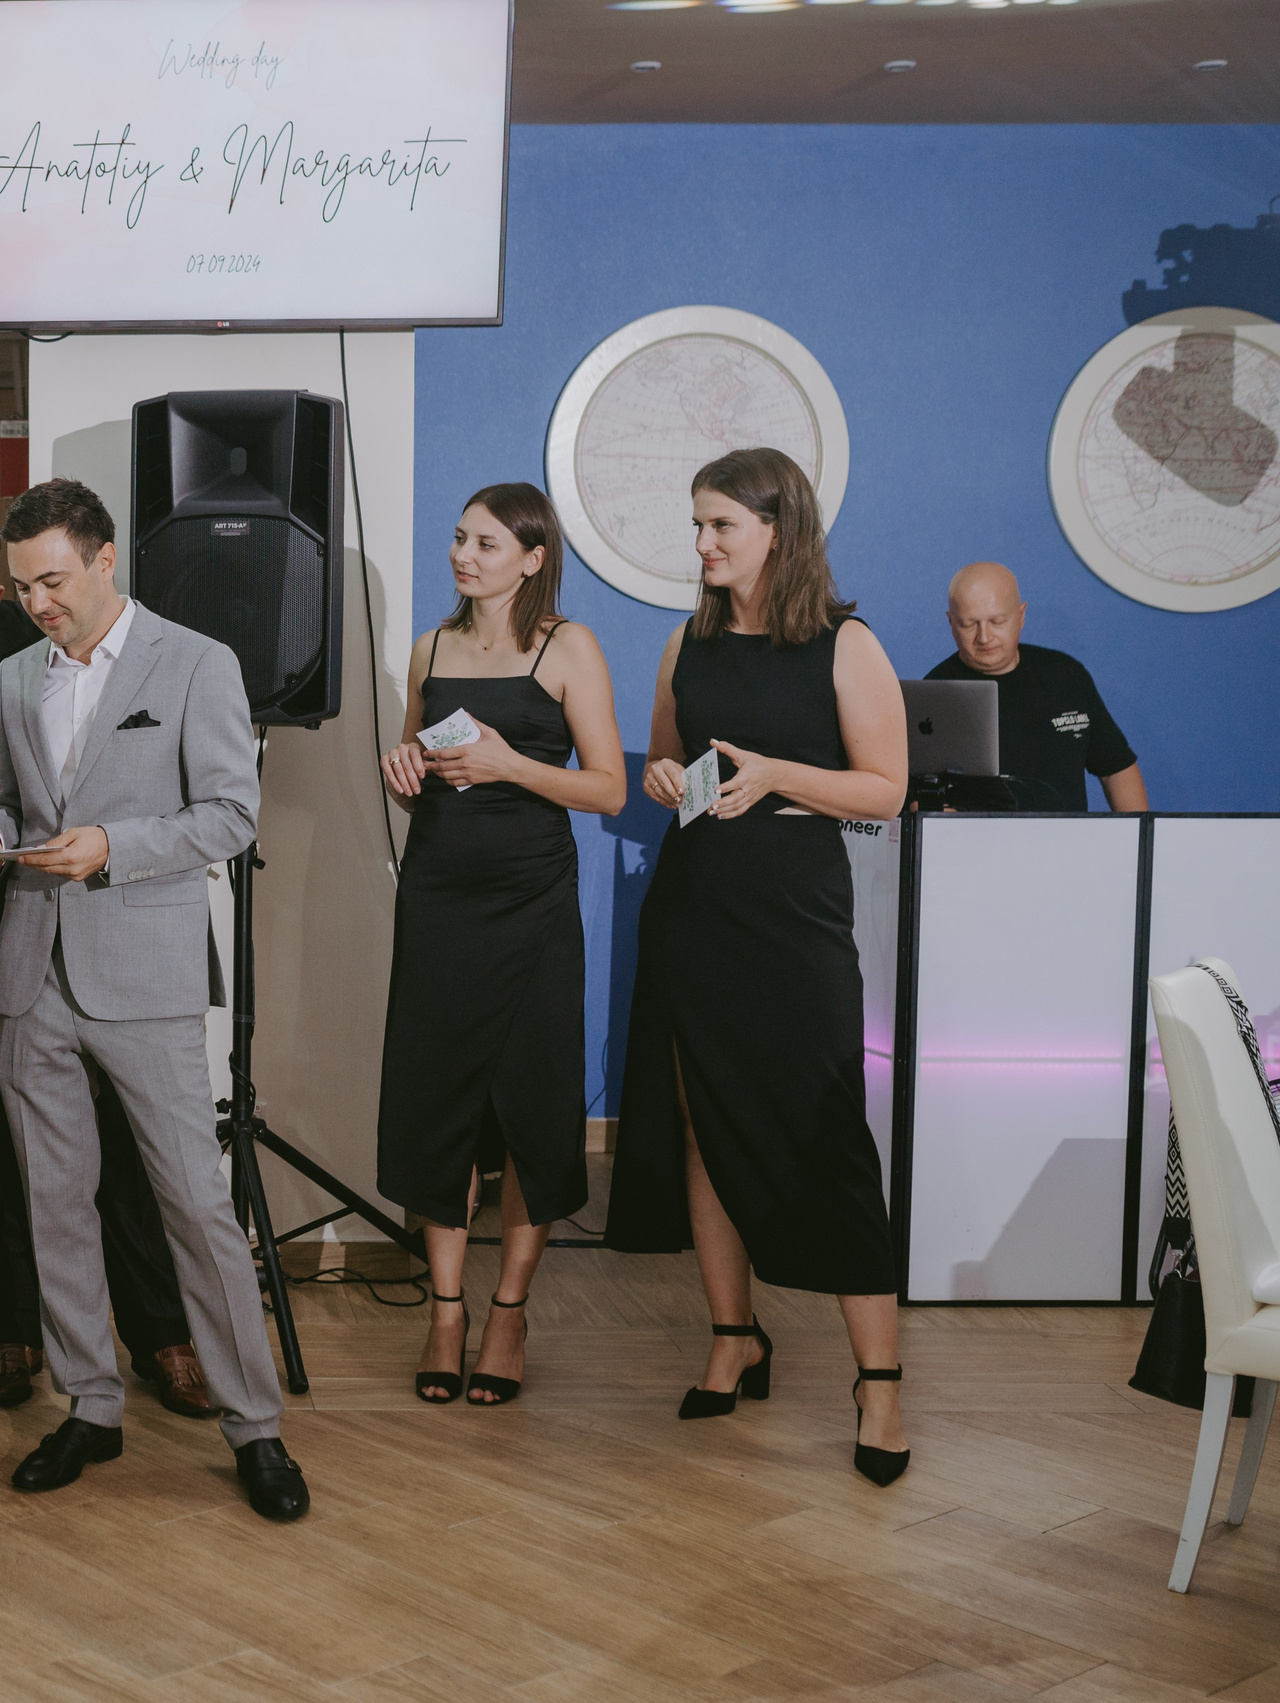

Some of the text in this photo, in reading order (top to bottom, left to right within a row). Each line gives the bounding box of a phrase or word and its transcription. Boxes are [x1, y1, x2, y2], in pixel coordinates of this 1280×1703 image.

[157, 38, 285, 91] Wedding day
[178, 146, 204, 185] &
[222, 120, 468, 224] Margarita
[186, 253, 261, 274] 07.09.2024
